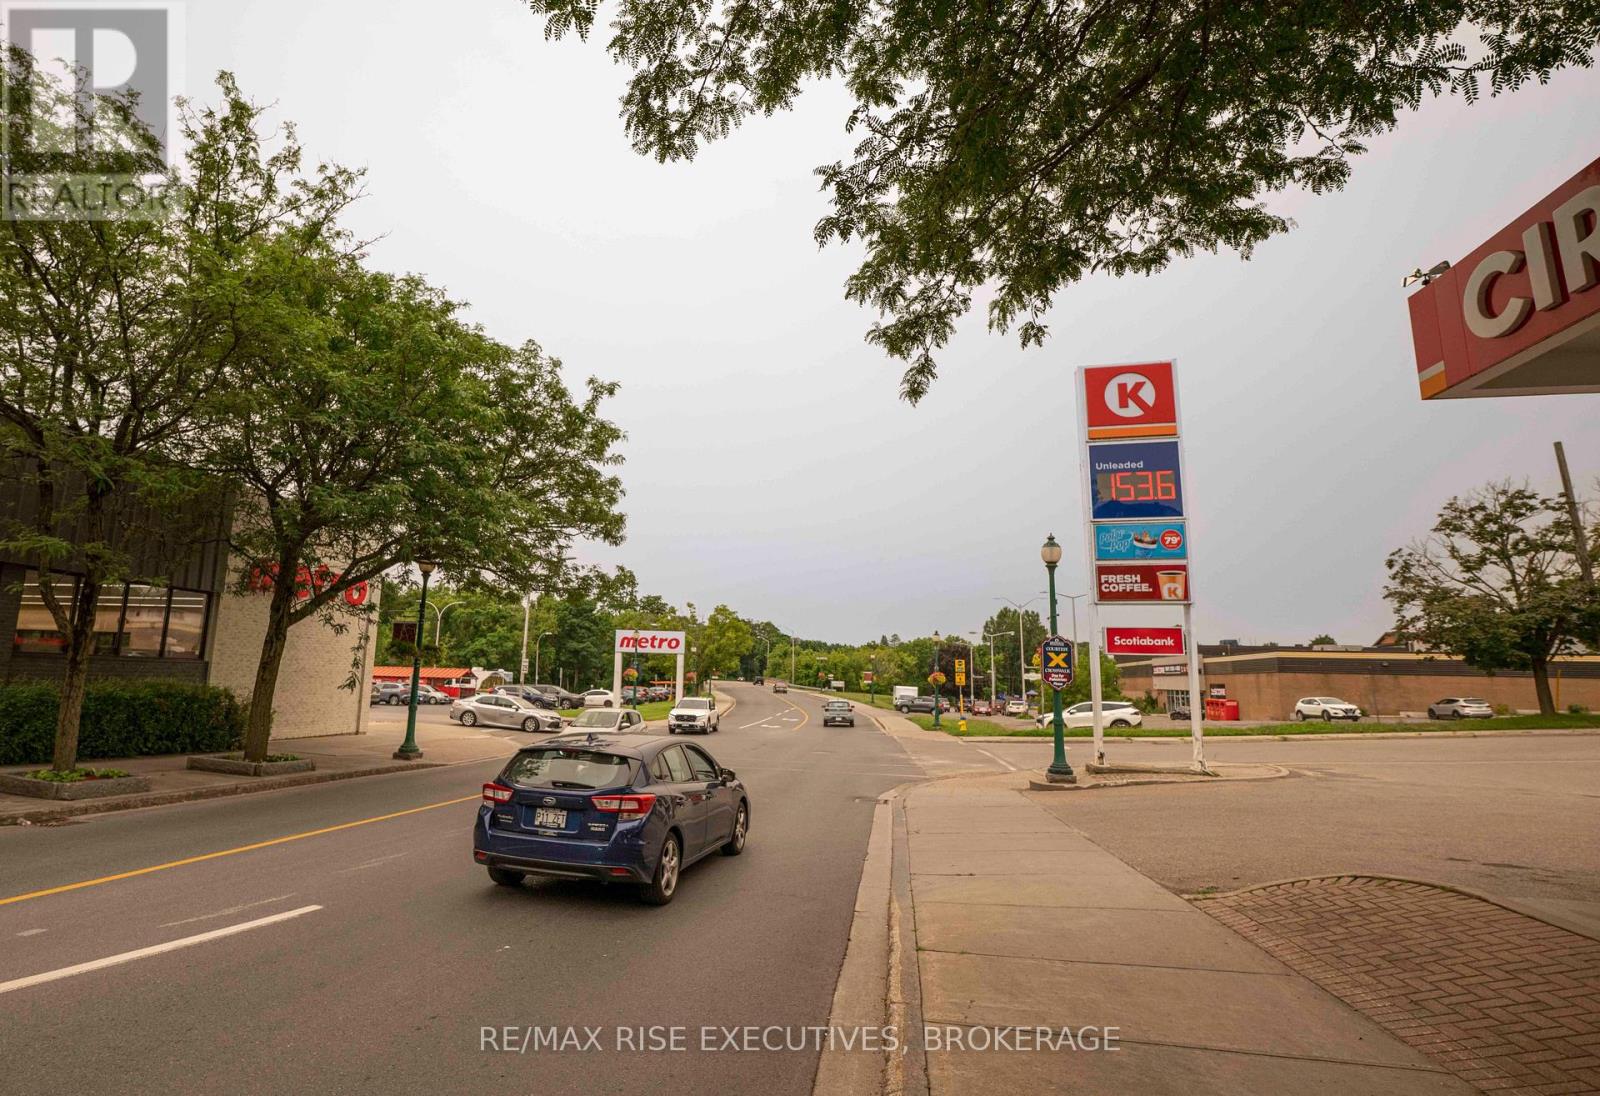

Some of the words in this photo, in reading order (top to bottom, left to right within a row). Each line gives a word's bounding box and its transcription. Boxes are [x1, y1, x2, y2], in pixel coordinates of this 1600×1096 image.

[1095, 460, 1143, 470] Unleaded
[1109, 470, 1176, 501] 153.6
[1100, 574, 1141, 584] FRESH
[1101, 583, 1153, 593] COFFEE.
[619, 635, 680, 649] metro
[1113, 636, 1175, 646] Scotiabank
